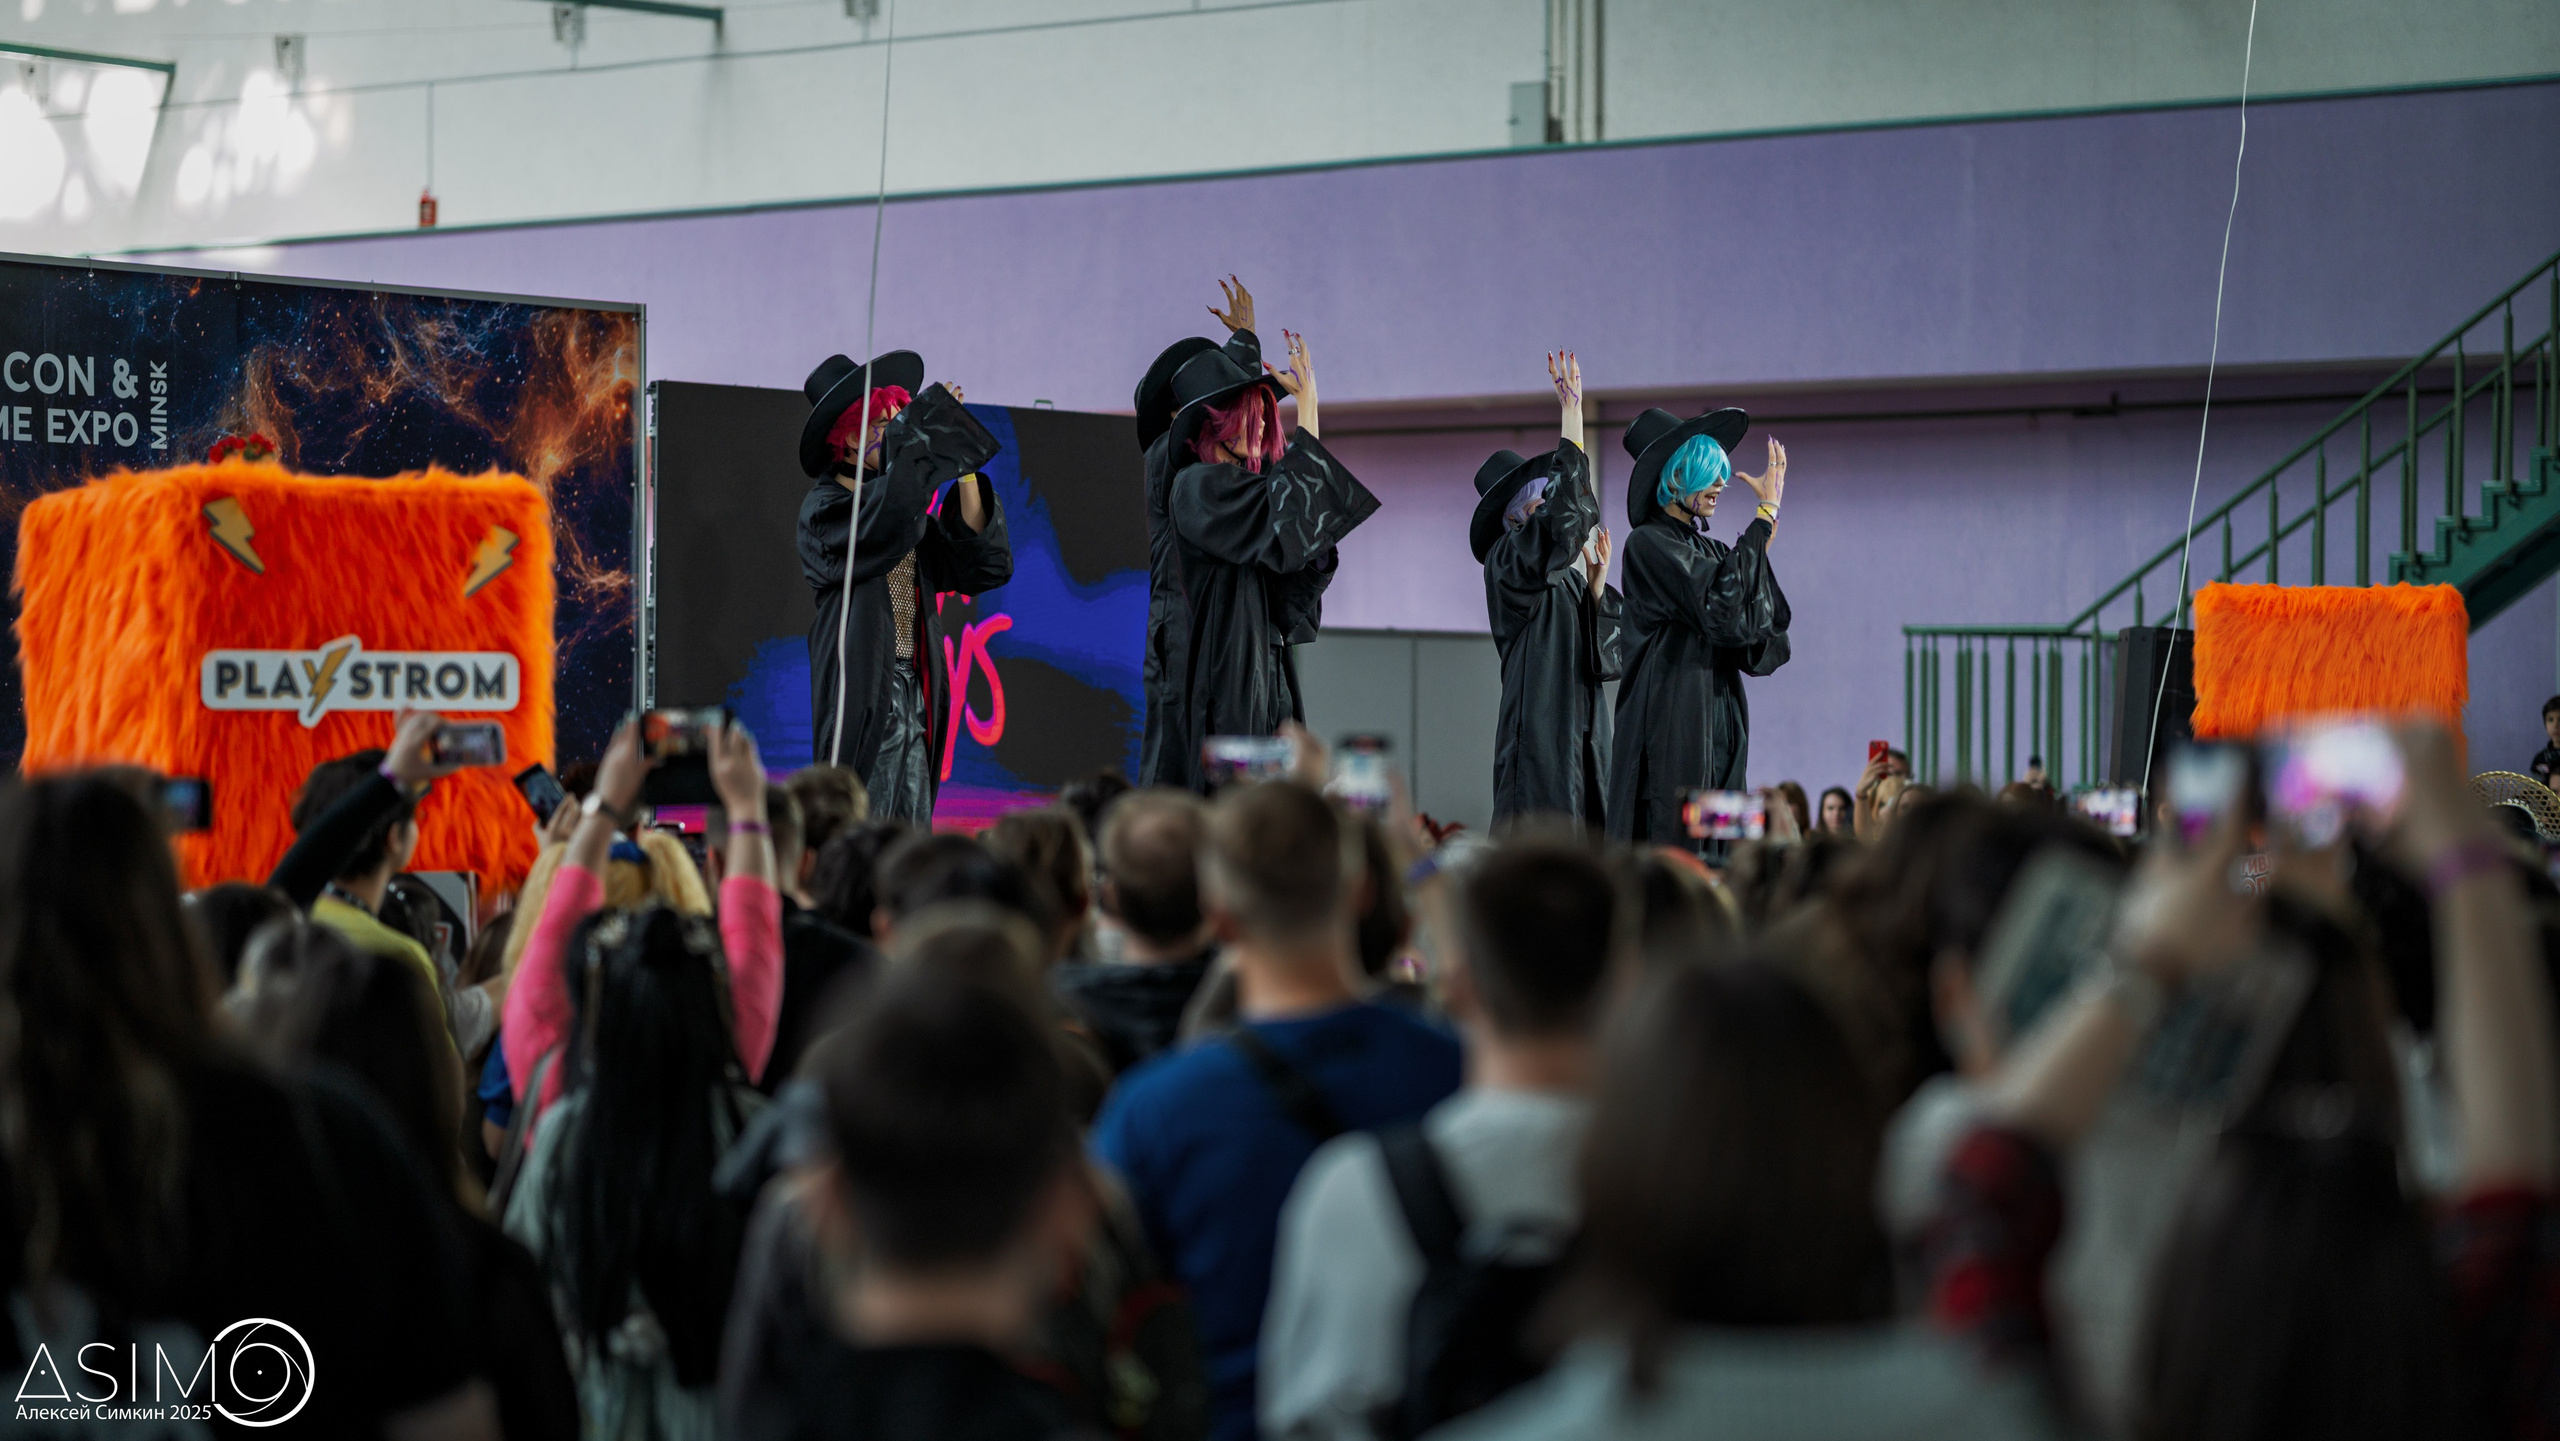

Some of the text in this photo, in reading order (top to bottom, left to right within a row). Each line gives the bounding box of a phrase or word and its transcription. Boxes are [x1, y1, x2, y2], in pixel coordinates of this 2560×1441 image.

[3, 351, 139, 399] CON &
[47, 407, 139, 447] EXPO
[150, 360, 168, 450] MINSK
